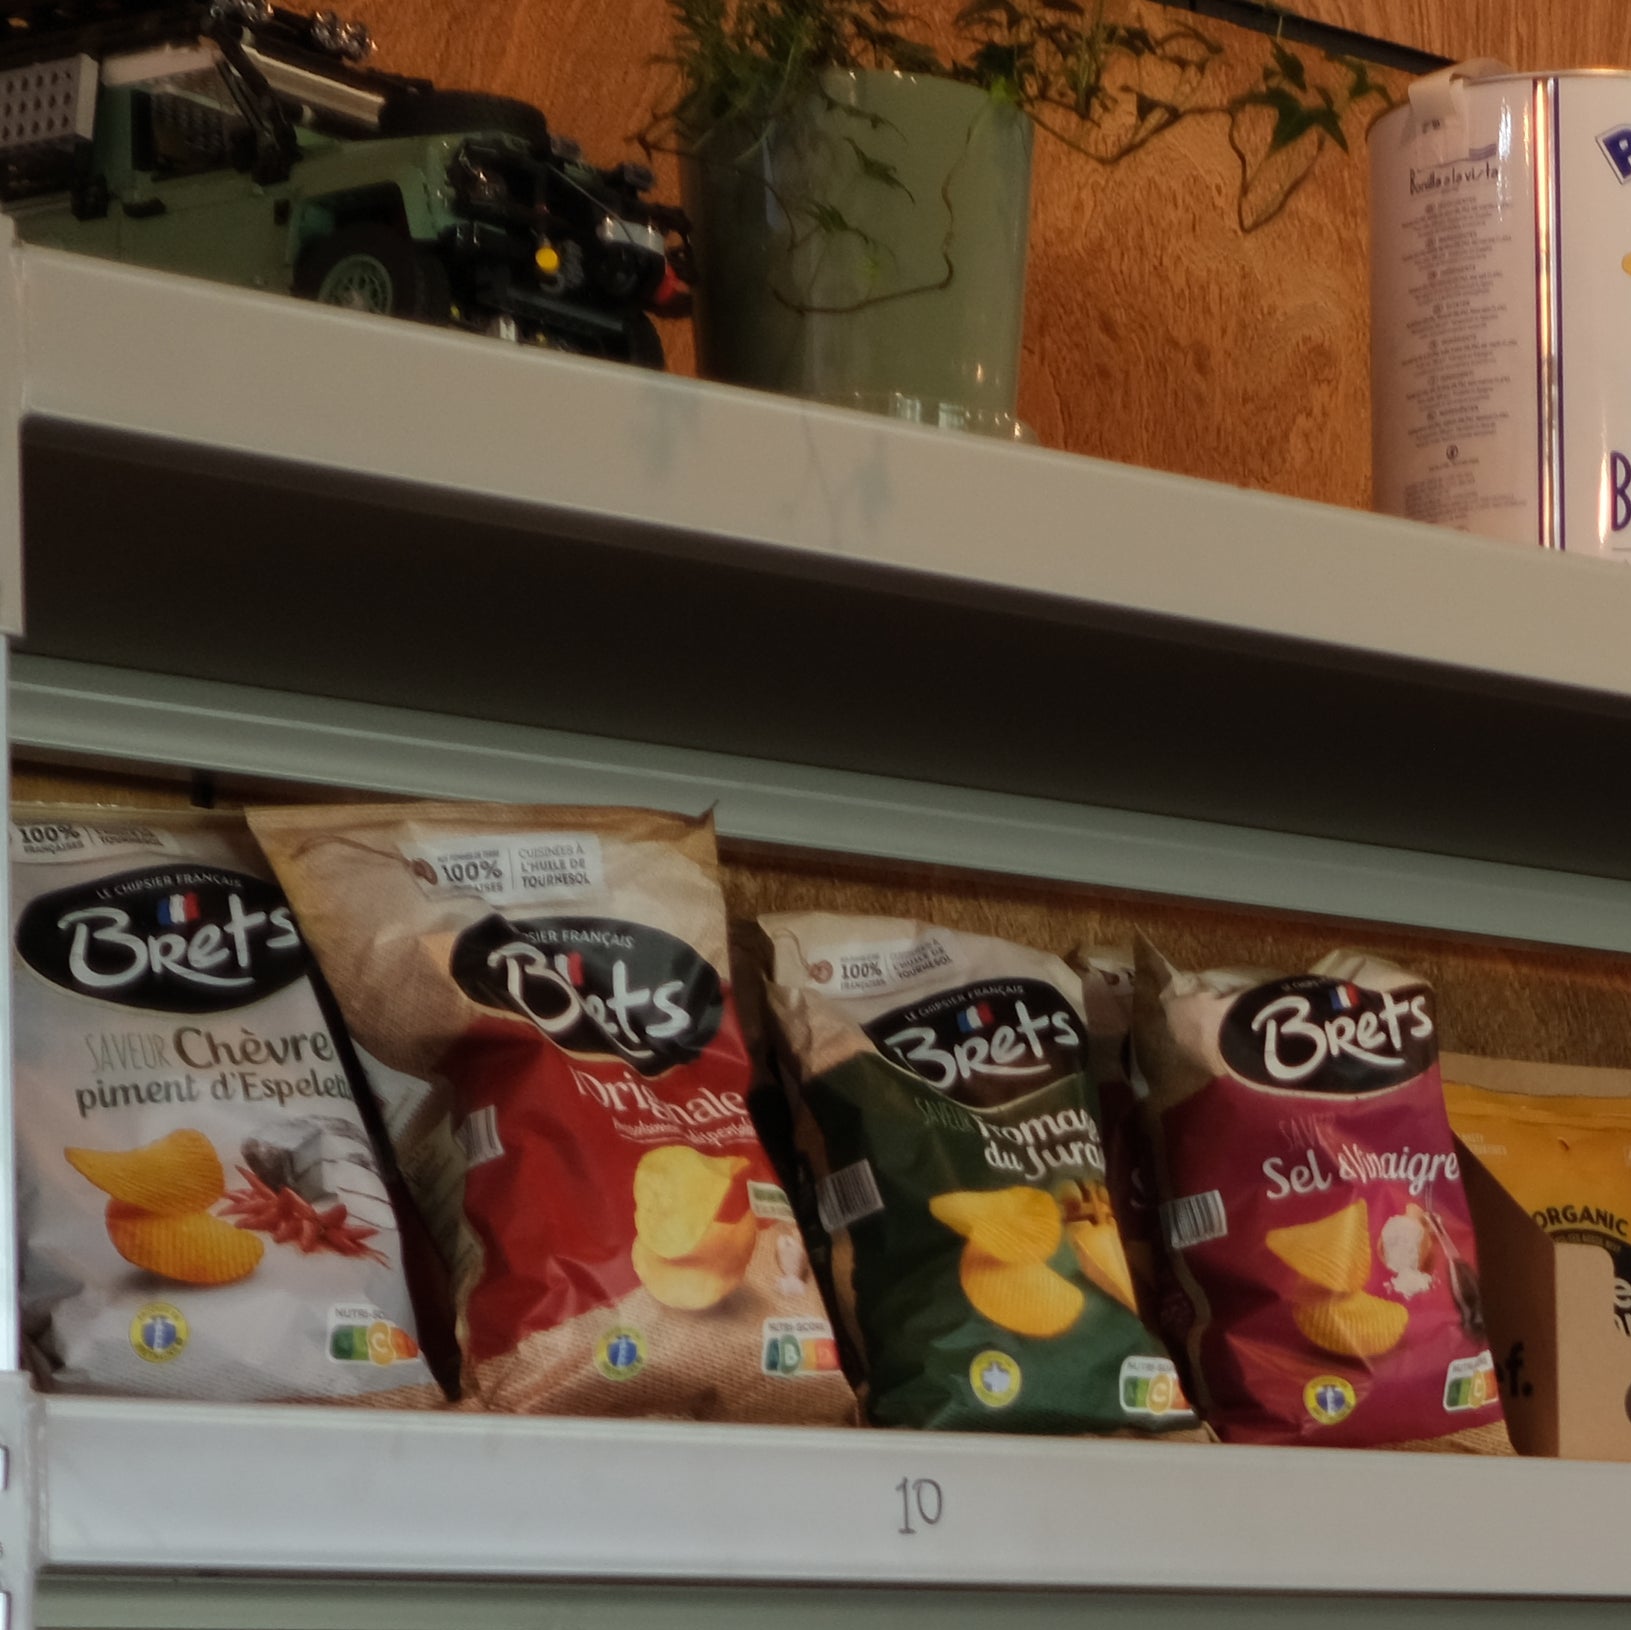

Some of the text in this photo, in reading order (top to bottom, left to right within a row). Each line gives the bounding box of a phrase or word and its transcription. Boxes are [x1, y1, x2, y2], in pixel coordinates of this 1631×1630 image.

[442, 860, 502, 883] 100%
[57, 893, 302, 988] Brets
[172, 1026, 334, 1070] Chèvre
[884, 1000, 1079, 1090] Brets
[1252, 992, 1433, 1081] Brets
[75, 1073, 198, 1118] piment
[1262, 1149, 1331, 1199] Sel
[896, 1474, 944, 1535] 10
